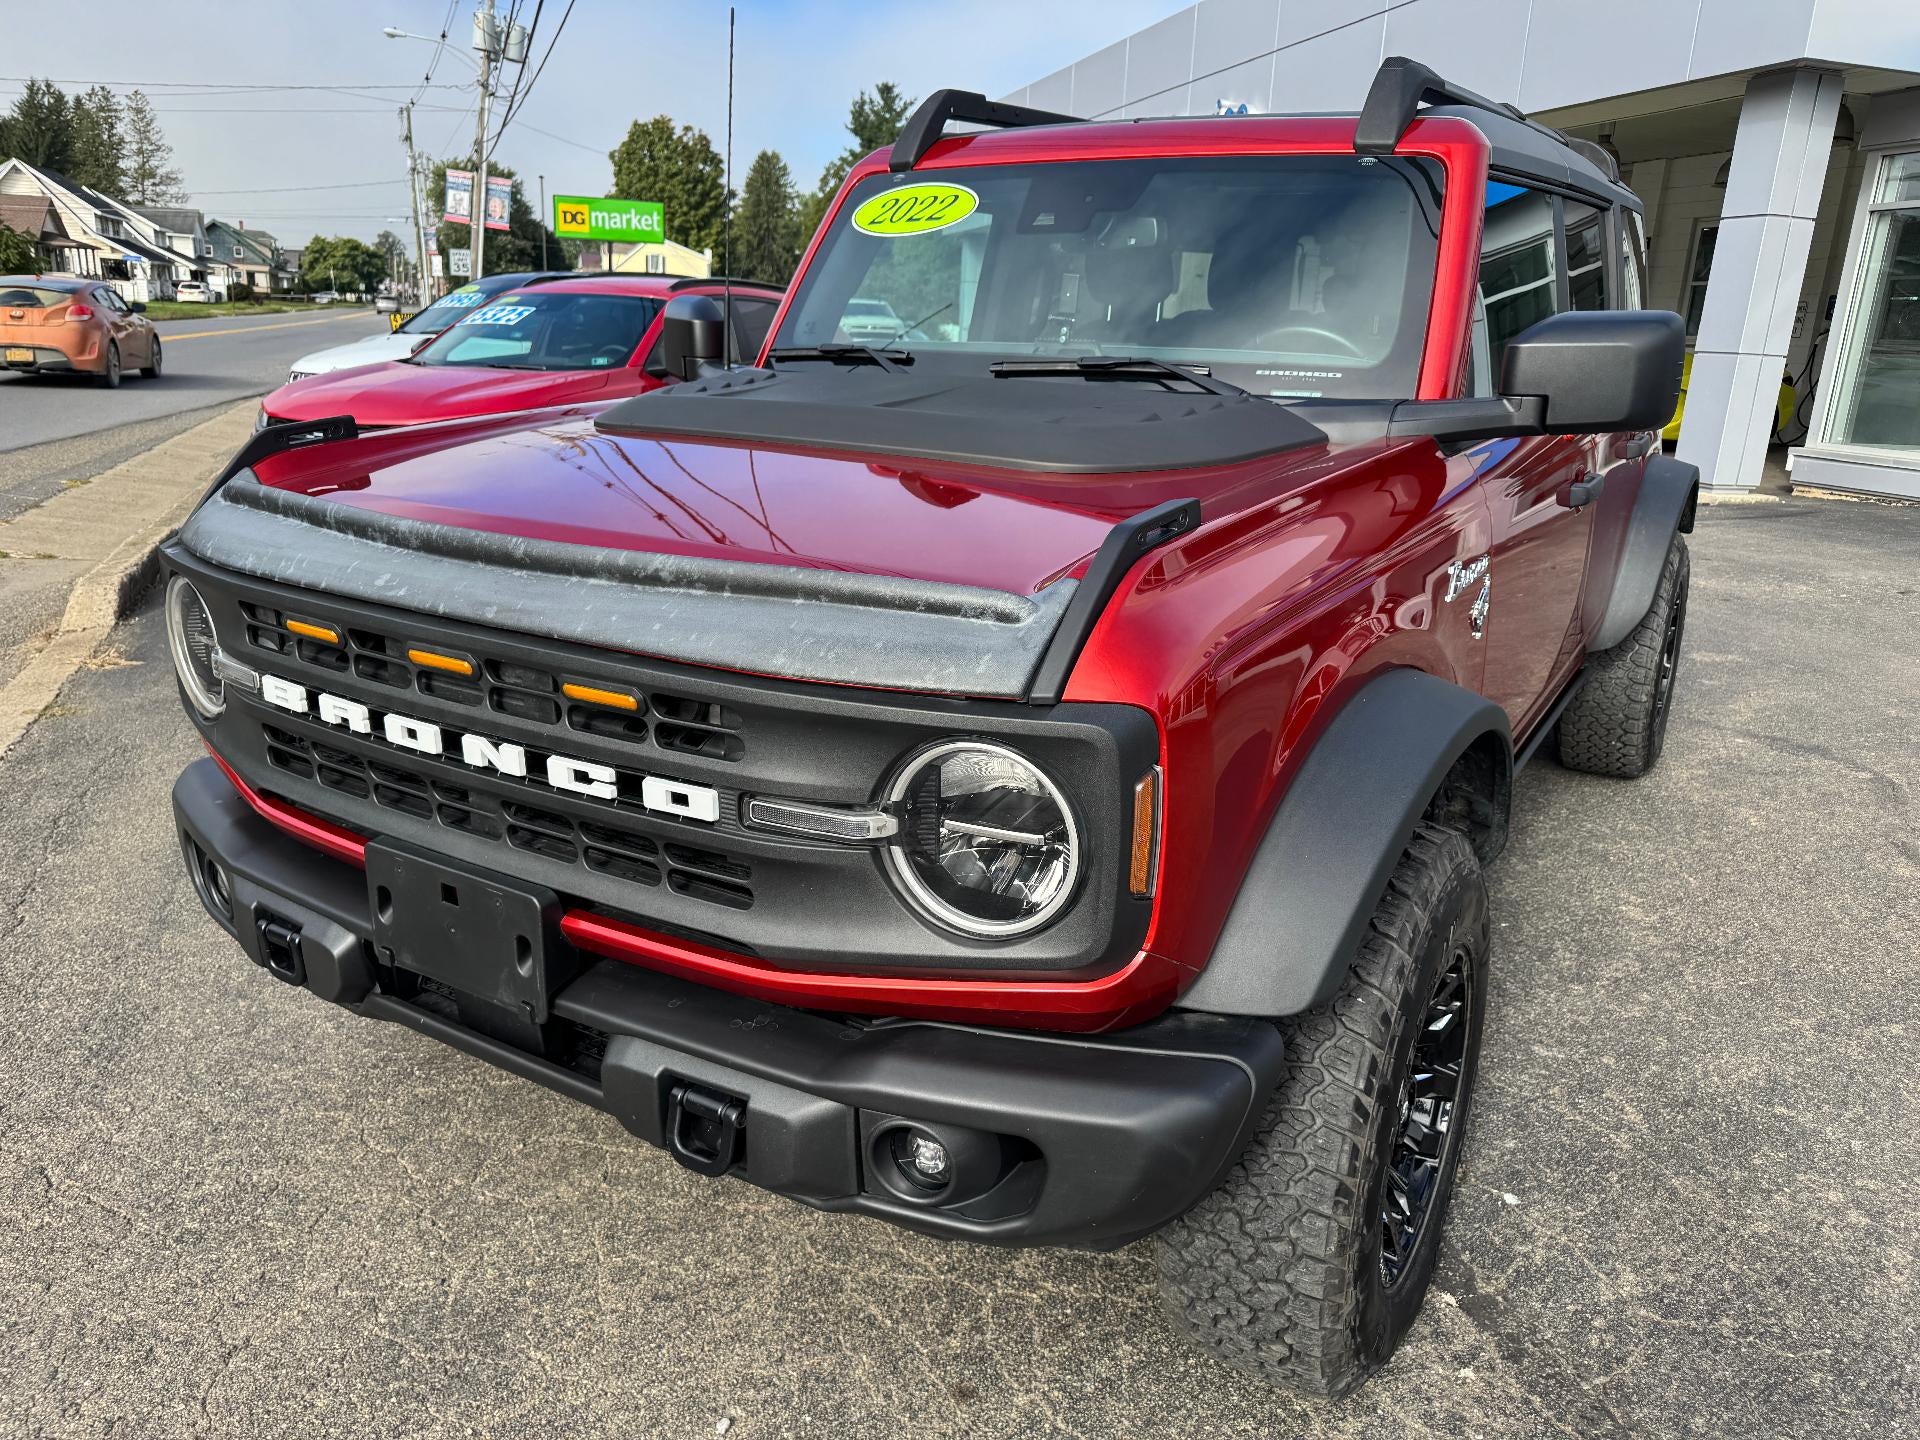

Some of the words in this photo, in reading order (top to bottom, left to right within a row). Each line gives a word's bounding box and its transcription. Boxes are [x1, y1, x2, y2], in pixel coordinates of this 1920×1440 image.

[561, 210, 586, 225] DG
[590, 207, 661, 232] market
[868, 194, 960, 226] 2022
[453, 262, 470, 273] 35
[261, 673, 720, 823] BRONCO
